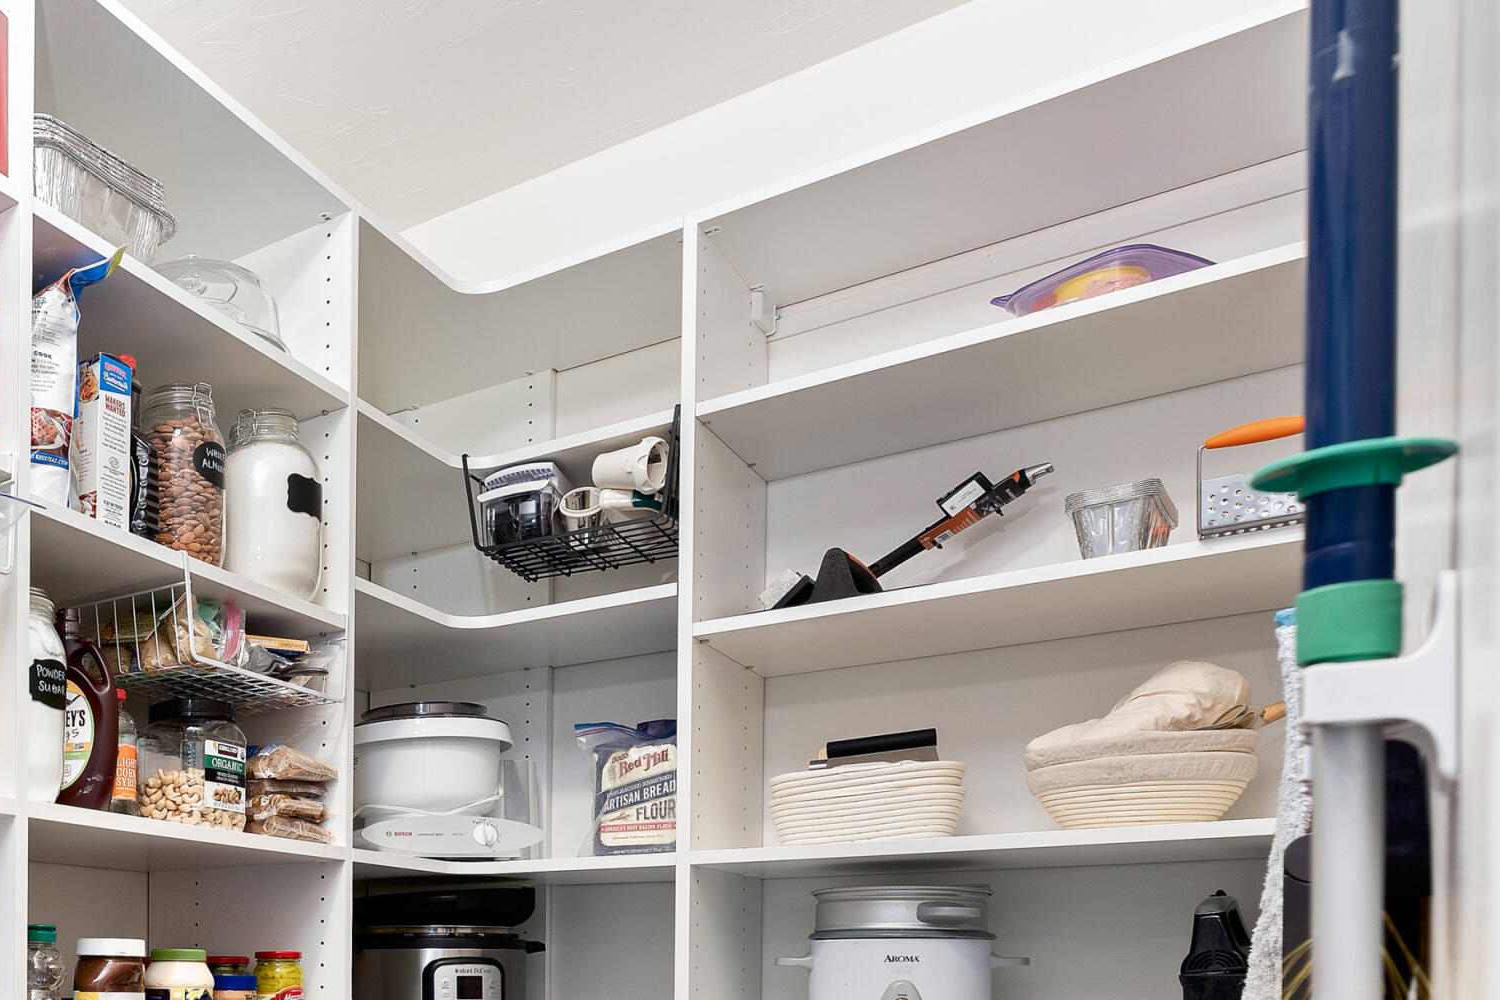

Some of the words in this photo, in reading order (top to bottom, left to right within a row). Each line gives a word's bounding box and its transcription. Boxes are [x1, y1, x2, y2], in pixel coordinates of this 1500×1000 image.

[104, 394, 126, 408] MAKERS
[105, 403, 126, 418] WANTED
[38, 680, 66, 696] SUGAR
[211, 757, 243, 773] ORGANIC
[619, 756, 642, 779] Red
[643, 748, 669, 771] Mill
[603, 790, 641, 813] ARTISAN
[643, 780, 676, 800] BREAD
[636, 799, 676, 820] FLOUR
[884, 954, 920, 963] AROMA
